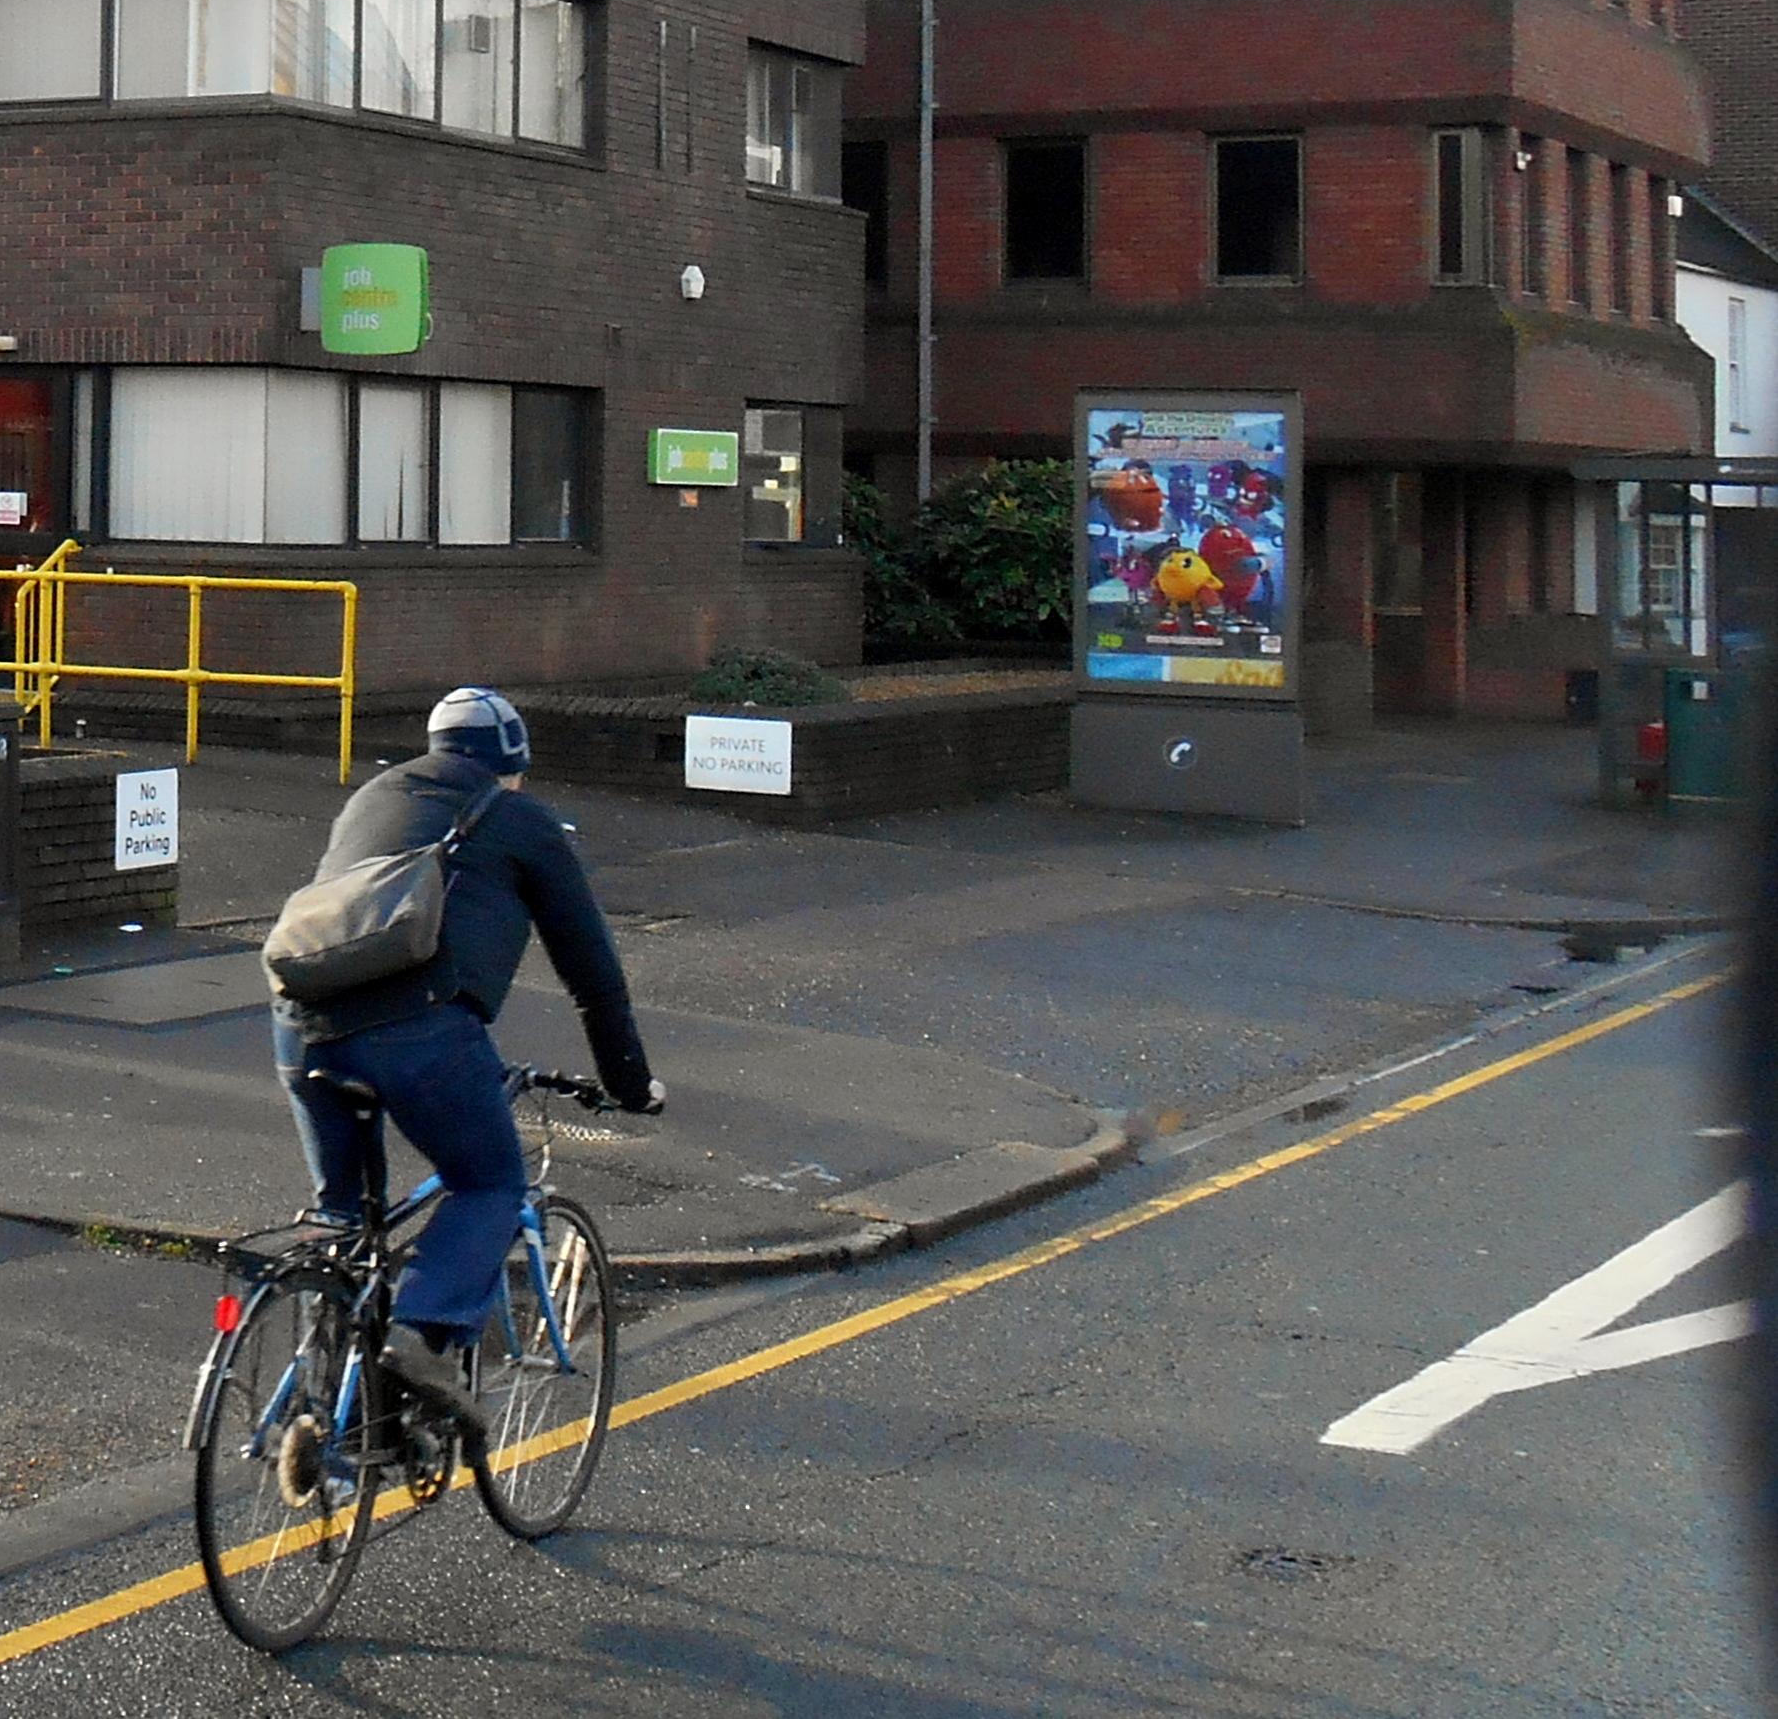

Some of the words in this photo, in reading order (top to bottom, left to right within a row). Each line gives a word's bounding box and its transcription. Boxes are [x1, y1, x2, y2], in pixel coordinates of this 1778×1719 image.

[343, 265, 372, 289] job
[341, 311, 380, 334] plus
[709, 736, 766, 754] PRIVATE
[692, 756, 717, 770] NO
[720, 757, 783, 776] PARKING
[140, 782, 157, 801] No
[129, 809, 166, 828] Public
[125, 836, 170, 855] Parking
